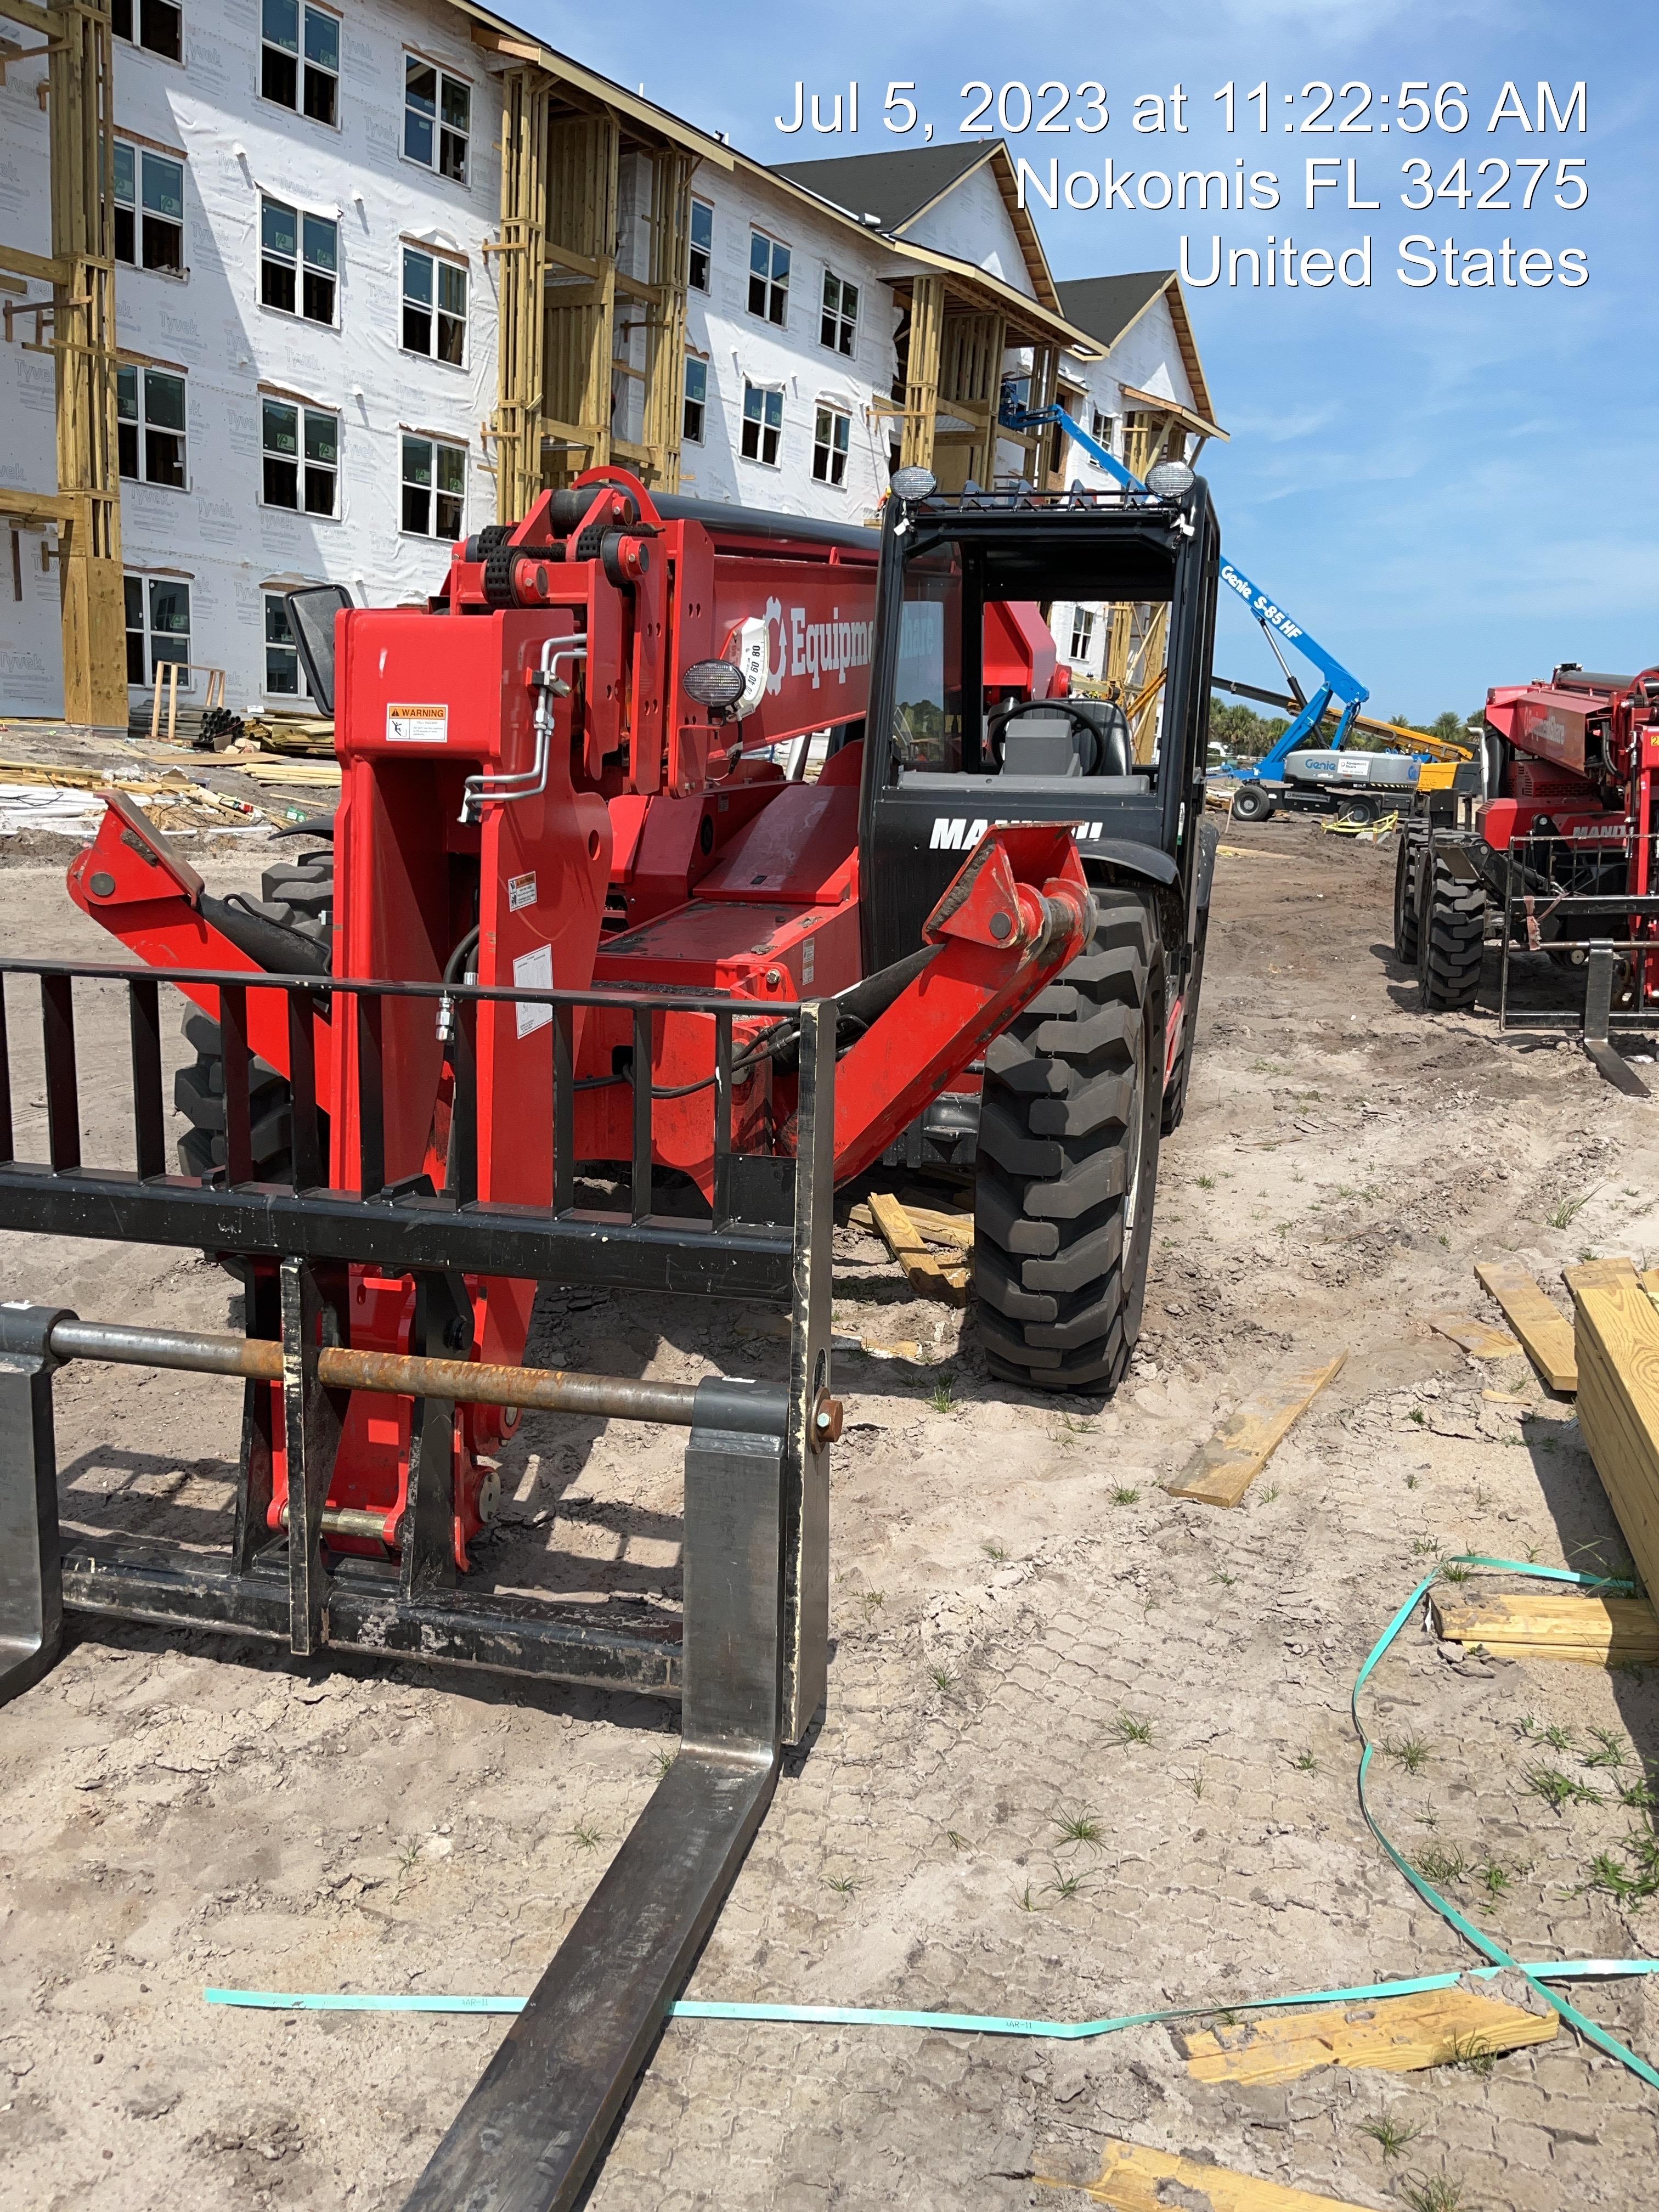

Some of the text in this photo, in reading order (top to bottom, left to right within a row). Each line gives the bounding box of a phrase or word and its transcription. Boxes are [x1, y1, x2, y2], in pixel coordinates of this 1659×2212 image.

[191, 221, 230, 249] Tyvek
[159, 311, 200, 337] Tyvek
[285, 346, 320, 370] Tyvek
[227, 409, 256, 431] Tyve
[129, 484, 171, 505] Tyvek
[196, 496, 235, 518] Tyvek
[259, 510, 294, 530] Tyvek
[234, 582, 260, 601] Tyve
[1221, 566, 1303, 638] Genie S-85 HF
[752, 645, 761, 657] 80
[0, 651, 45, 673] Tyvek
[751, 661, 760, 673] 60
[748, 675, 757, 686] 40
[402, 708, 444, 718] WARNING
[1305, 758, 1336, 771] Genie
[1572, 825, 1627, 837] MANIT
